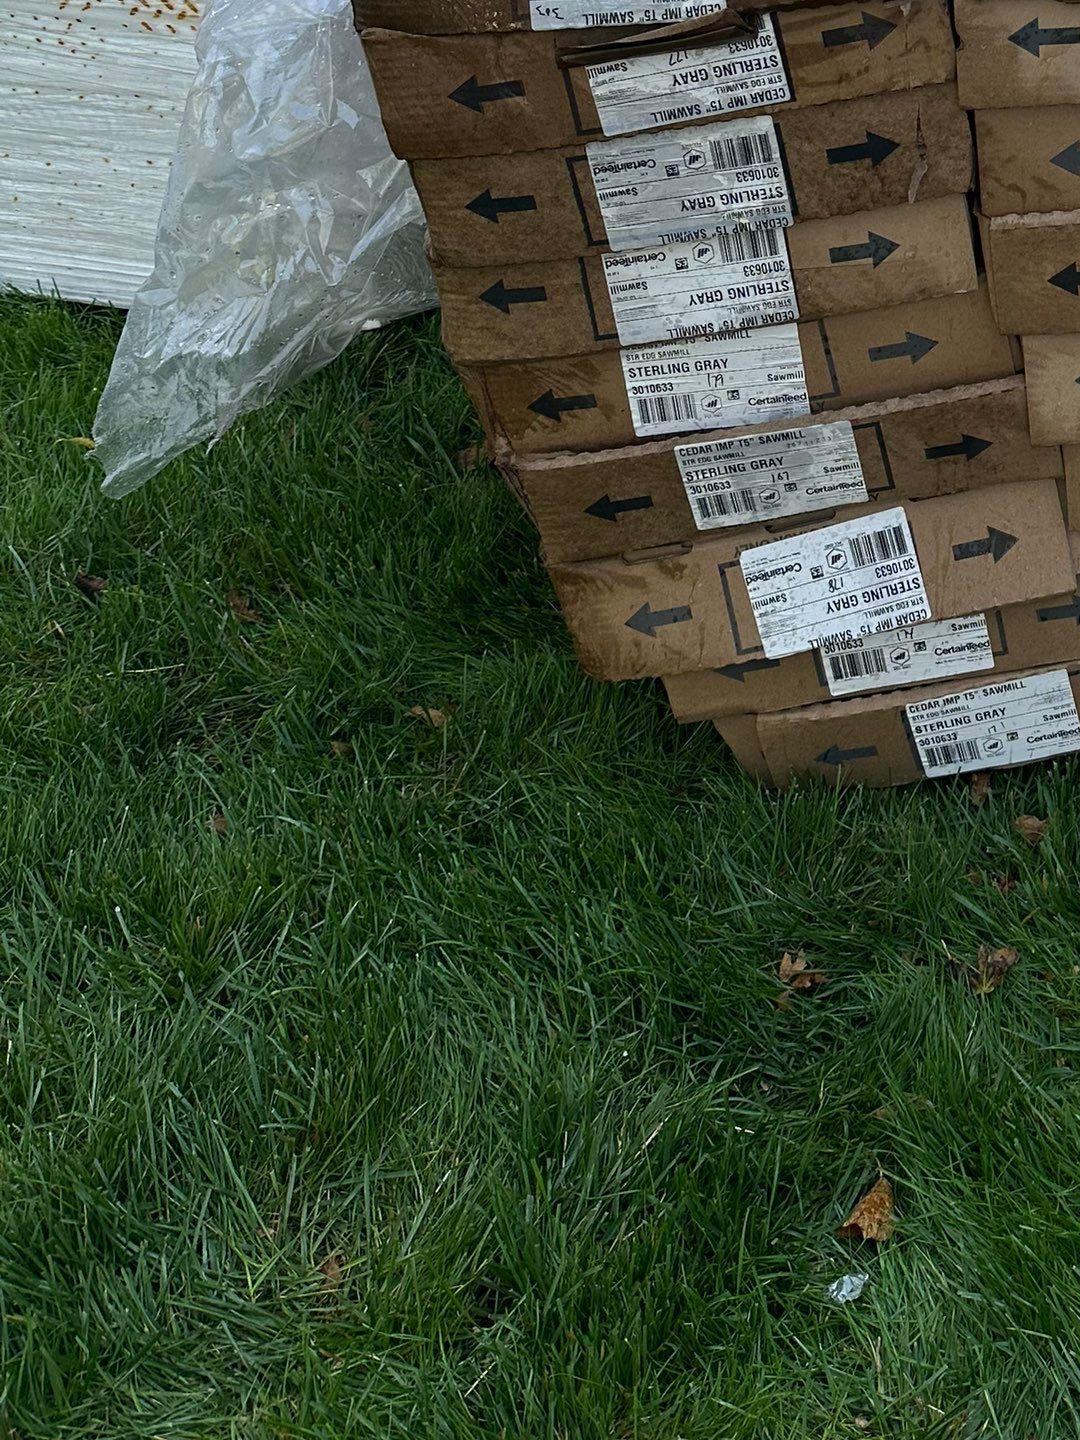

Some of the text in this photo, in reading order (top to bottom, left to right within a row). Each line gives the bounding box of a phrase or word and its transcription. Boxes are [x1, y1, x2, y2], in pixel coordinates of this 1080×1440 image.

[588, 62, 628, 79] Sawmill
[672, 55, 779, 87] STERLING GRAY
[651, 87, 786, 123] CEDAR IMP T5" SAWMILL
[736, 167, 780, 183] 3010633
[600, 187, 638, 201] Sawmill
[681, 187, 784, 212] STERLING GRAY
[605, 252, 666, 269] CertainTeed
[743, 260, 785, 277] 3010633
[610, 281, 648, 295] Sawmill
[689, 280, 790, 306] STERLING GRAY
[738, 317, 758, 329] IMP
[762, 311, 794, 325] CEDAR
[667, 322, 714, 338] SAWMILL
[628, 358, 728, 378] STERLING GRAY
[768, 370, 804, 382] Sawmill
[632, 383, 674, 395] 3010633
[748, 392, 807, 406] CertainTeed
[679, 431, 806, 457] CEDAR IMP T5" SAWMILL
[685, 457, 784, 481] STERLING GRAY
[823, 463, 859, 474] Sawmill
[690, 481, 731, 495] 3010633
[875, 558, 915, 578] 3010633
[752, 594, 787, 611] Sawmill
[826, 577, 920, 614] STERLING GRAY
[875, 619, 894, 632] IMP
[896, 609, 927, 626] CEDAR
[951, 620, 985, 632] Sawmill
[935, 641, 990, 656] CertainTeed
[909, 681, 1027, 713] CEDAR IMP T5" SAWMILL
[915, 708, 1006, 734] STERLING GRAY
[1043, 709, 1077, 722] Sawmill
[919, 733, 958, 747] 3010633
[1027, 727, 1080, 744] CertainTeed
